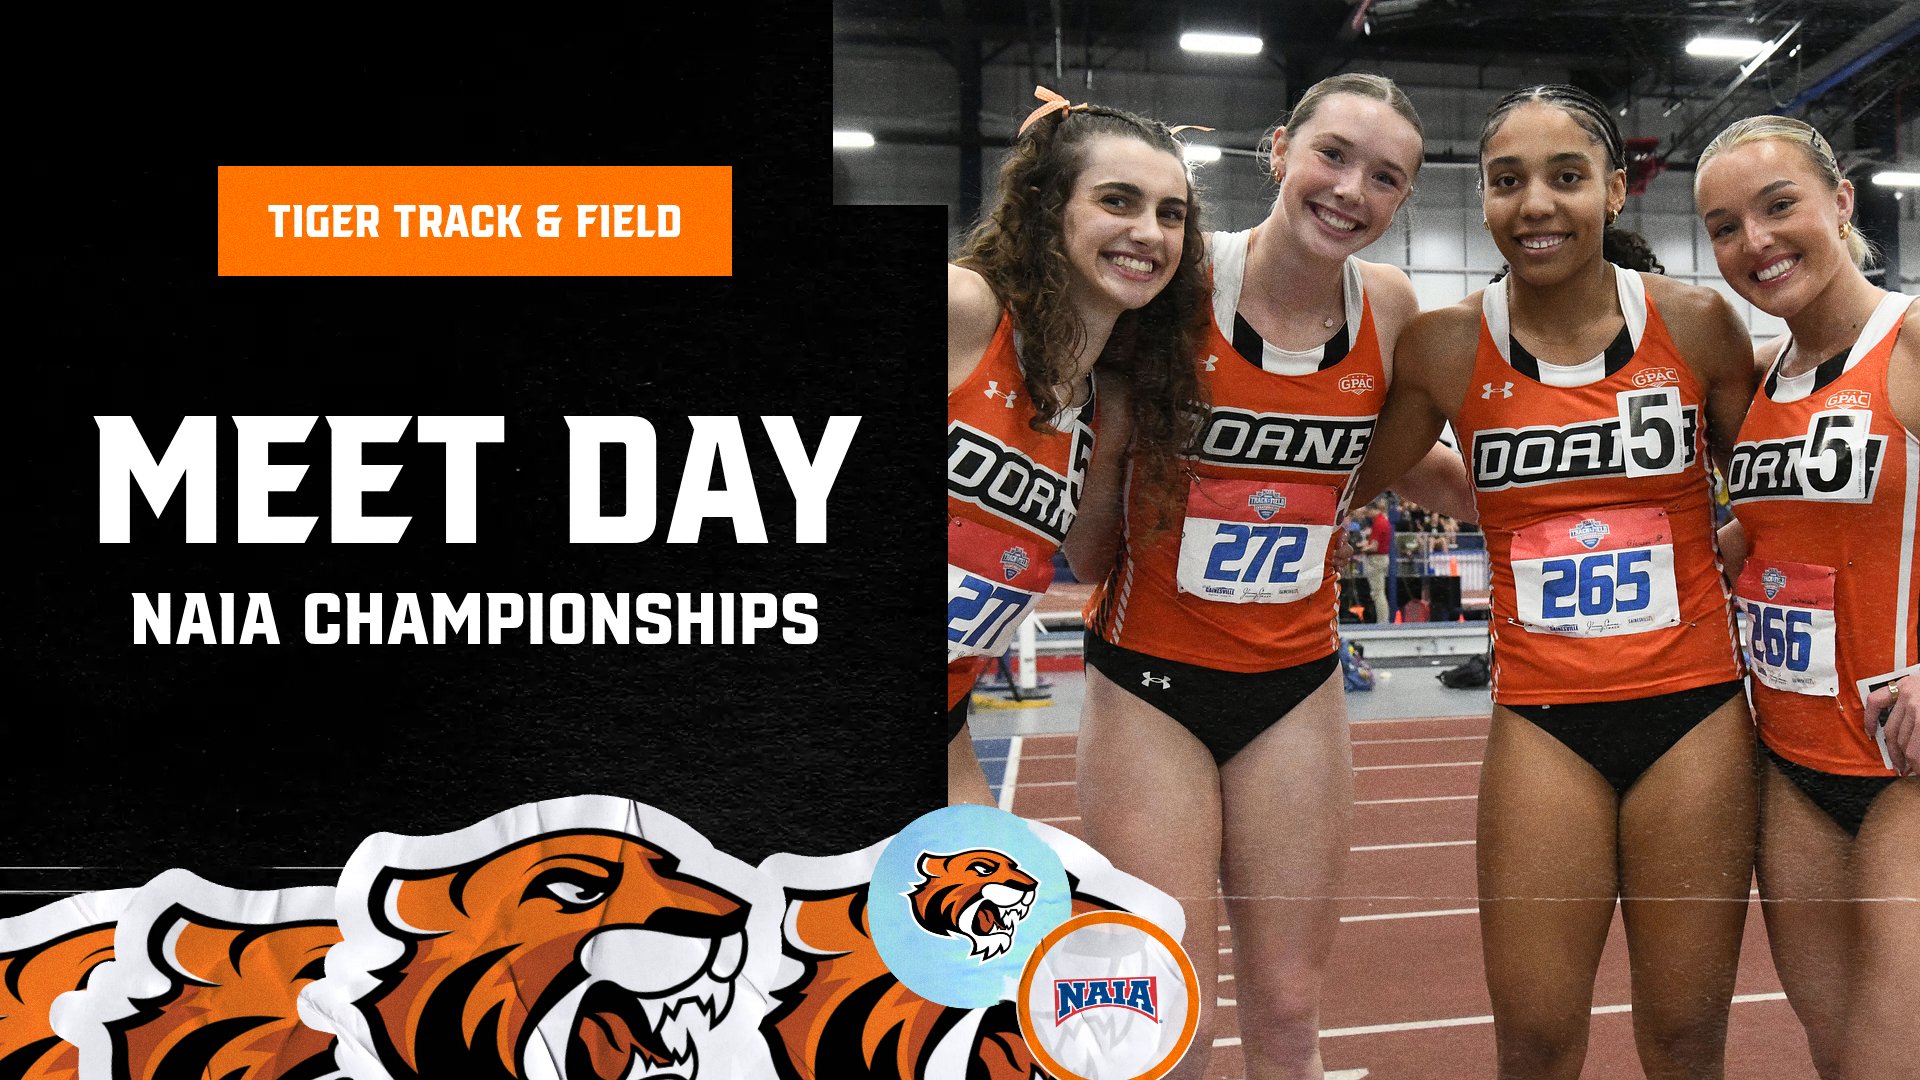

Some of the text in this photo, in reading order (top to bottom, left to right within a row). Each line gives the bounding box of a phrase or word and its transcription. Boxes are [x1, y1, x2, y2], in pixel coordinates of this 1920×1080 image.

[1341, 378, 1373, 390] GPAC
[1634, 370, 1677, 386] GPAC
[1827, 394, 1869, 406] GPAC
[1479, 418, 1691, 481] DOA
[1628, 393, 1676, 470] 5
[1806, 415, 1853, 493] 5
[1204, 523, 1308, 583] 272
[1541, 550, 1652, 619] 265
[1747, 603, 1812, 672] 266
